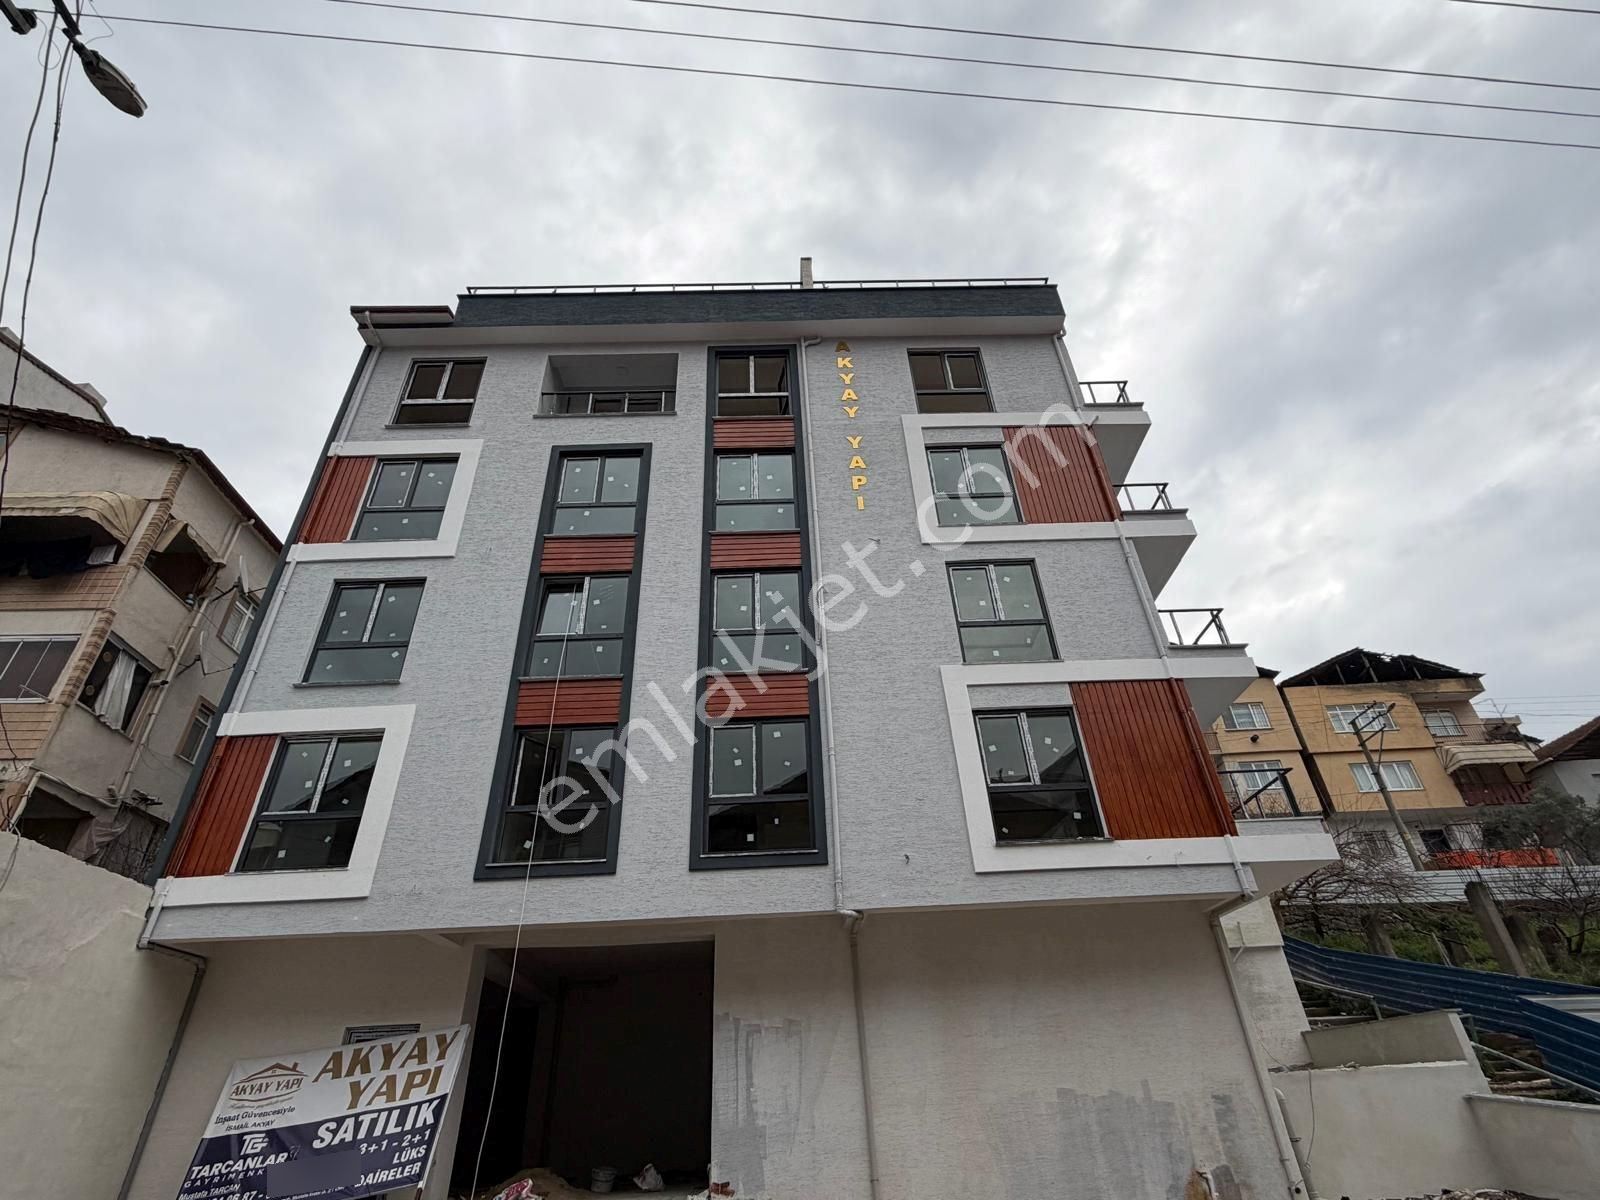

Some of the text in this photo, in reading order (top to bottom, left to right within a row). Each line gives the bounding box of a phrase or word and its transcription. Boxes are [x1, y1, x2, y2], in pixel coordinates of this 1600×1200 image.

[835, 341, 868, 510] AKYAY YAPI
[312, 1030, 460, 1083] AKYAY
[230, 1078, 304, 1097] AKYAY YAPI
[346, 1065, 444, 1110] YAPI
[251, 1119, 276, 1128] AKYAY
[312, 1099, 440, 1149] SATILIK
[402, 1129, 431, 1147] 2+1
[190, 1152, 289, 1179] TARCANLAR
[392, 1145, 427, 1164] LÜKS
[209, 1184, 241, 1196] TARCAN
